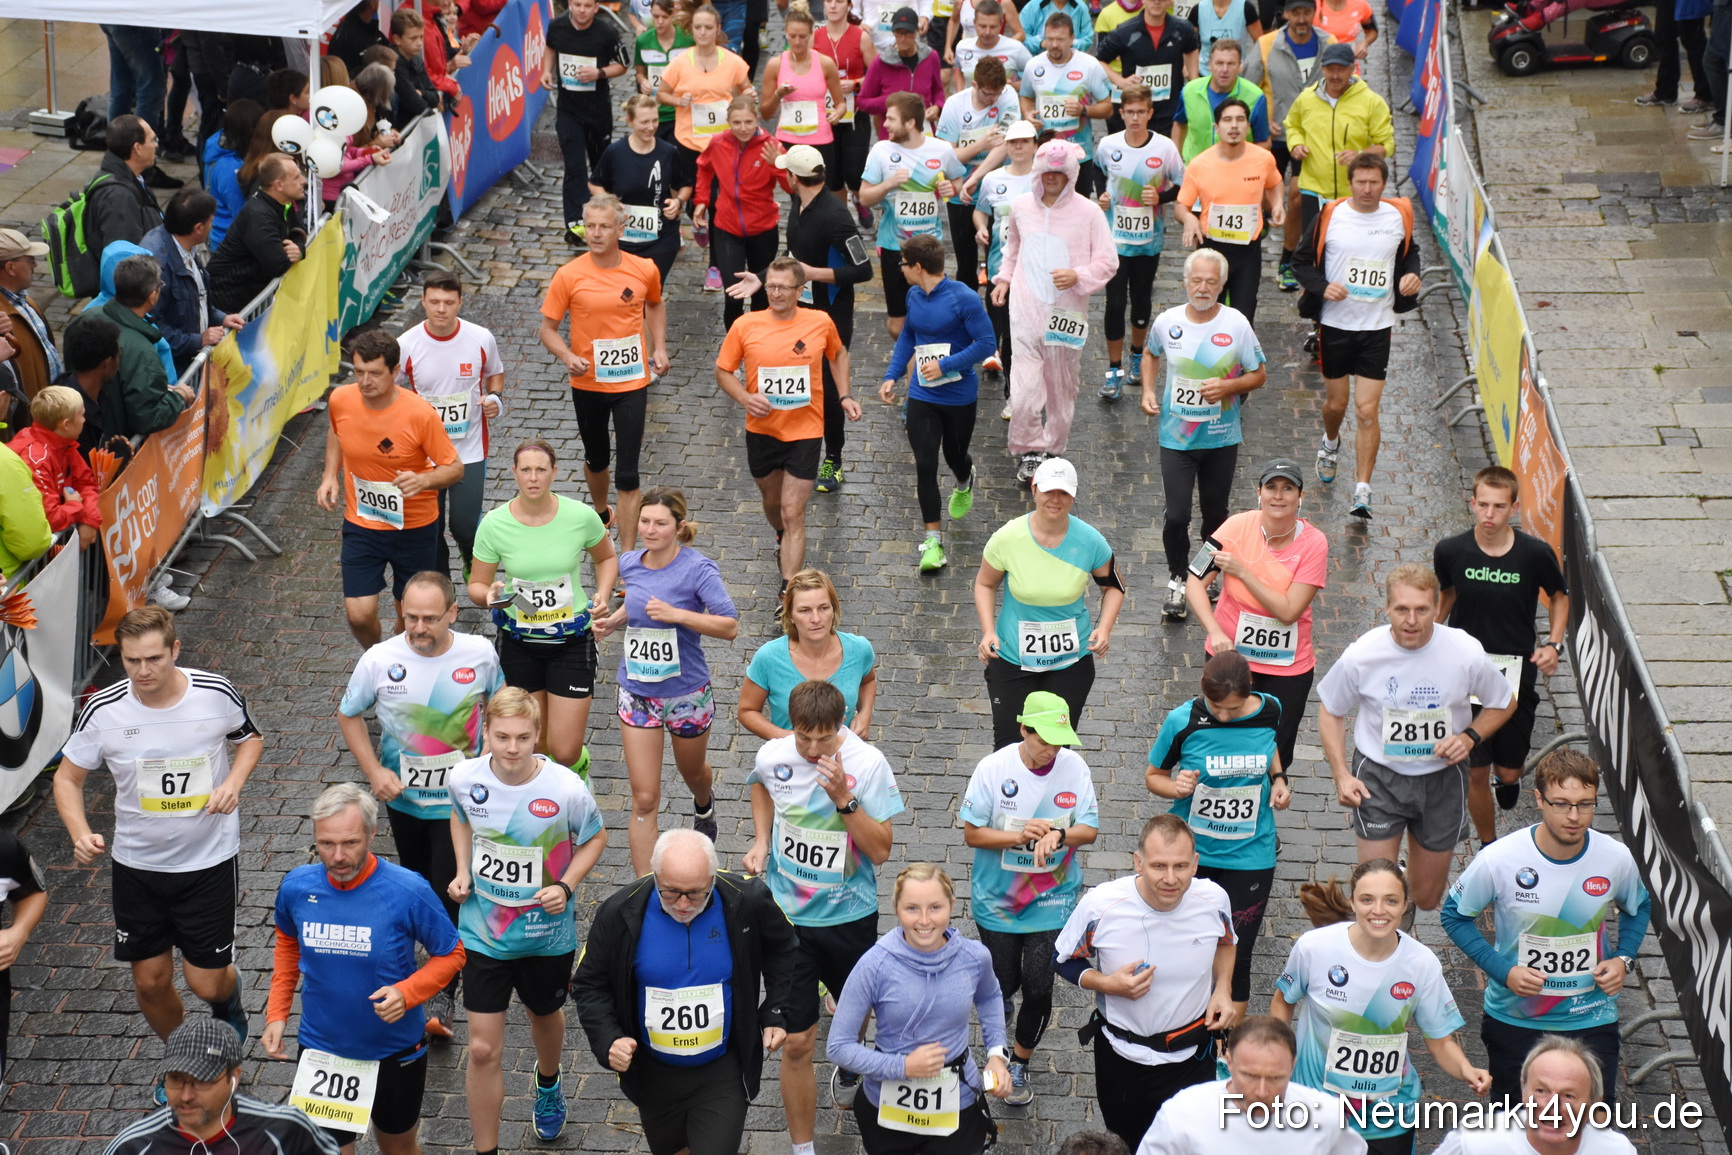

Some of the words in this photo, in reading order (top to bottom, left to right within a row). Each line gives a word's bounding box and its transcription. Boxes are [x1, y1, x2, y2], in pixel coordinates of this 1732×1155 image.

[488, 61, 524, 125] Hervis
[708, 111, 716, 124] 9
[795, 111, 802, 124] 8
[899, 201, 935, 216] 2486
[624, 215, 654, 231] 240
[902, 218, 930, 226] Alexander
[1116, 215, 1150, 231] 3079
[1217, 214, 1243, 230] 143
[1348, 267, 1387, 287] 3105
[1048, 315, 1085, 337] 3081
[599, 345, 639, 366] 2258
[607, 367, 634, 377] Michael
[763, 377, 806, 395] 2124
[1176, 387, 1216, 406] 227
[432, 402, 468, 423] 757
[1180, 407, 1211, 416] Raimund
[358, 488, 398, 512] 2096
[1464, 566, 1521, 584] adidas
[531, 589, 557, 608] 58
[530, 611, 559, 622] Martina
[1025, 632, 1074, 654] 2105
[1241, 626, 1291, 648] 2661
[630, 638, 673, 662] 2469
[1250, 649, 1278, 658] Bettina
[1036, 656, 1063, 666] Kerstin
[641, 665, 660, 675] Julia
[1389, 720, 1446, 742] 2816
[1404, 746, 1431, 755] Georg
[1205, 754, 1268, 769] HUBER
[161, 772, 191, 796] 67
[407, 766, 454, 788] 277
[418, 790, 449, 798] Manfre
[160, 800, 192, 810] Stefan
[532, 803, 556, 814] Hervis
[1197, 798, 1255, 819] 2533
[1206, 821, 1238, 833] Andrea
[783, 836, 840, 869] 2067
[478, 853, 533, 884] 2291
[795, 863, 819, 881] Hans
[489, 884, 521, 900] Tobias
[1586, 880, 1609, 892] Hervis
[1515, 891, 1540, 900] PARTL
[525, 911, 543, 924] 17.
[525, 919, 562, 931] Neumarkter
[302, 921, 372, 943] HUBER
[314, 940, 369, 950] TECHNOLOGY
[349, 950, 369, 958] Solutions
[1526, 948, 1591, 974] 2382
[1393, 985, 1413, 997] Hervis
[1543, 978, 1578, 989] homas
[1325, 987, 1348, 999] PARTL
[660, 1003, 710, 1031] 260
[672, 1036, 699, 1047] Ernst
[1334, 1045, 1400, 1075] 2080
[308, 1069, 361, 1102] 208
[1351, 1079, 1377, 1091] Julia
[896, 1084, 943, 1111] 261
[304, 1101, 354, 1123] Wolfgang
[907, 1114, 930, 1126] Resi
